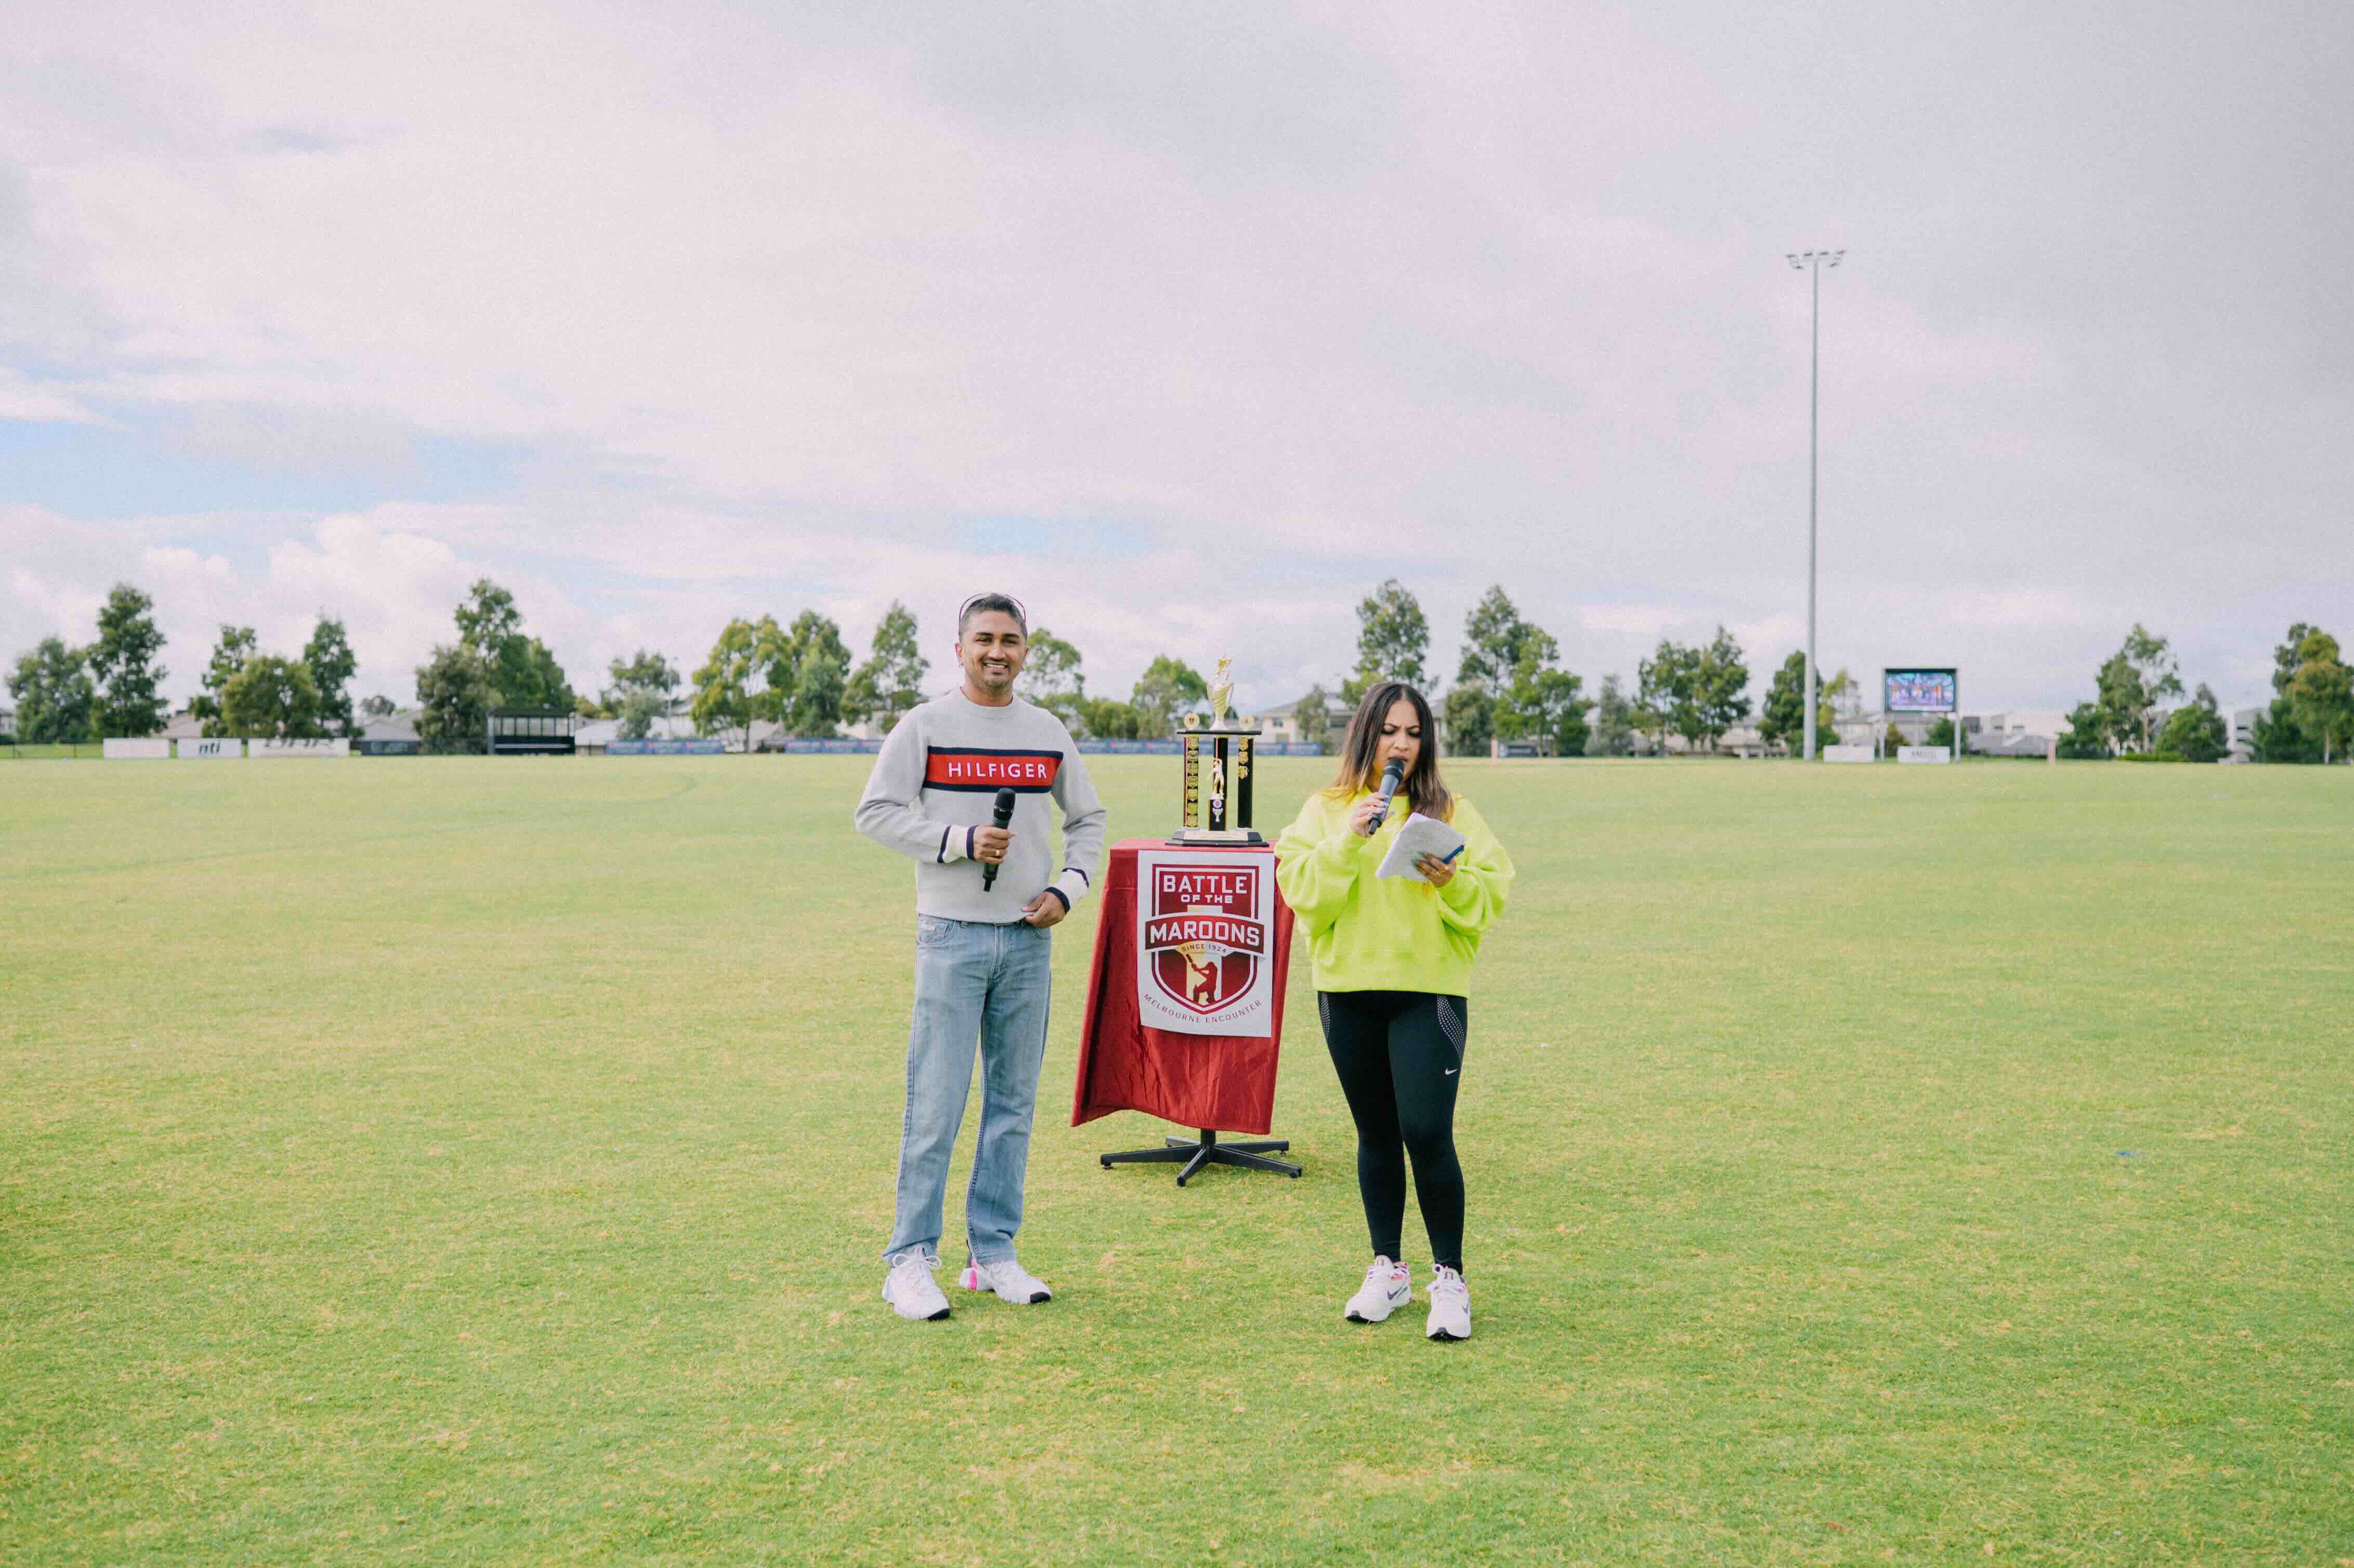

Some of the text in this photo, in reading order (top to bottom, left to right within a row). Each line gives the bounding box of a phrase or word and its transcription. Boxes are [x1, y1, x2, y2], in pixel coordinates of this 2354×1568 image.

[948, 762, 1047, 778] HILFIGER
[1163, 874, 1247, 894] BATTLE
[1181, 894, 1233, 904] OF THE
[1150, 921, 1260, 946] MAROONS
[1181, 944, 1227, 952] SINCE 1924
[1144, 994, 1262, 1023] MELBOURNE ENCOUNTER
